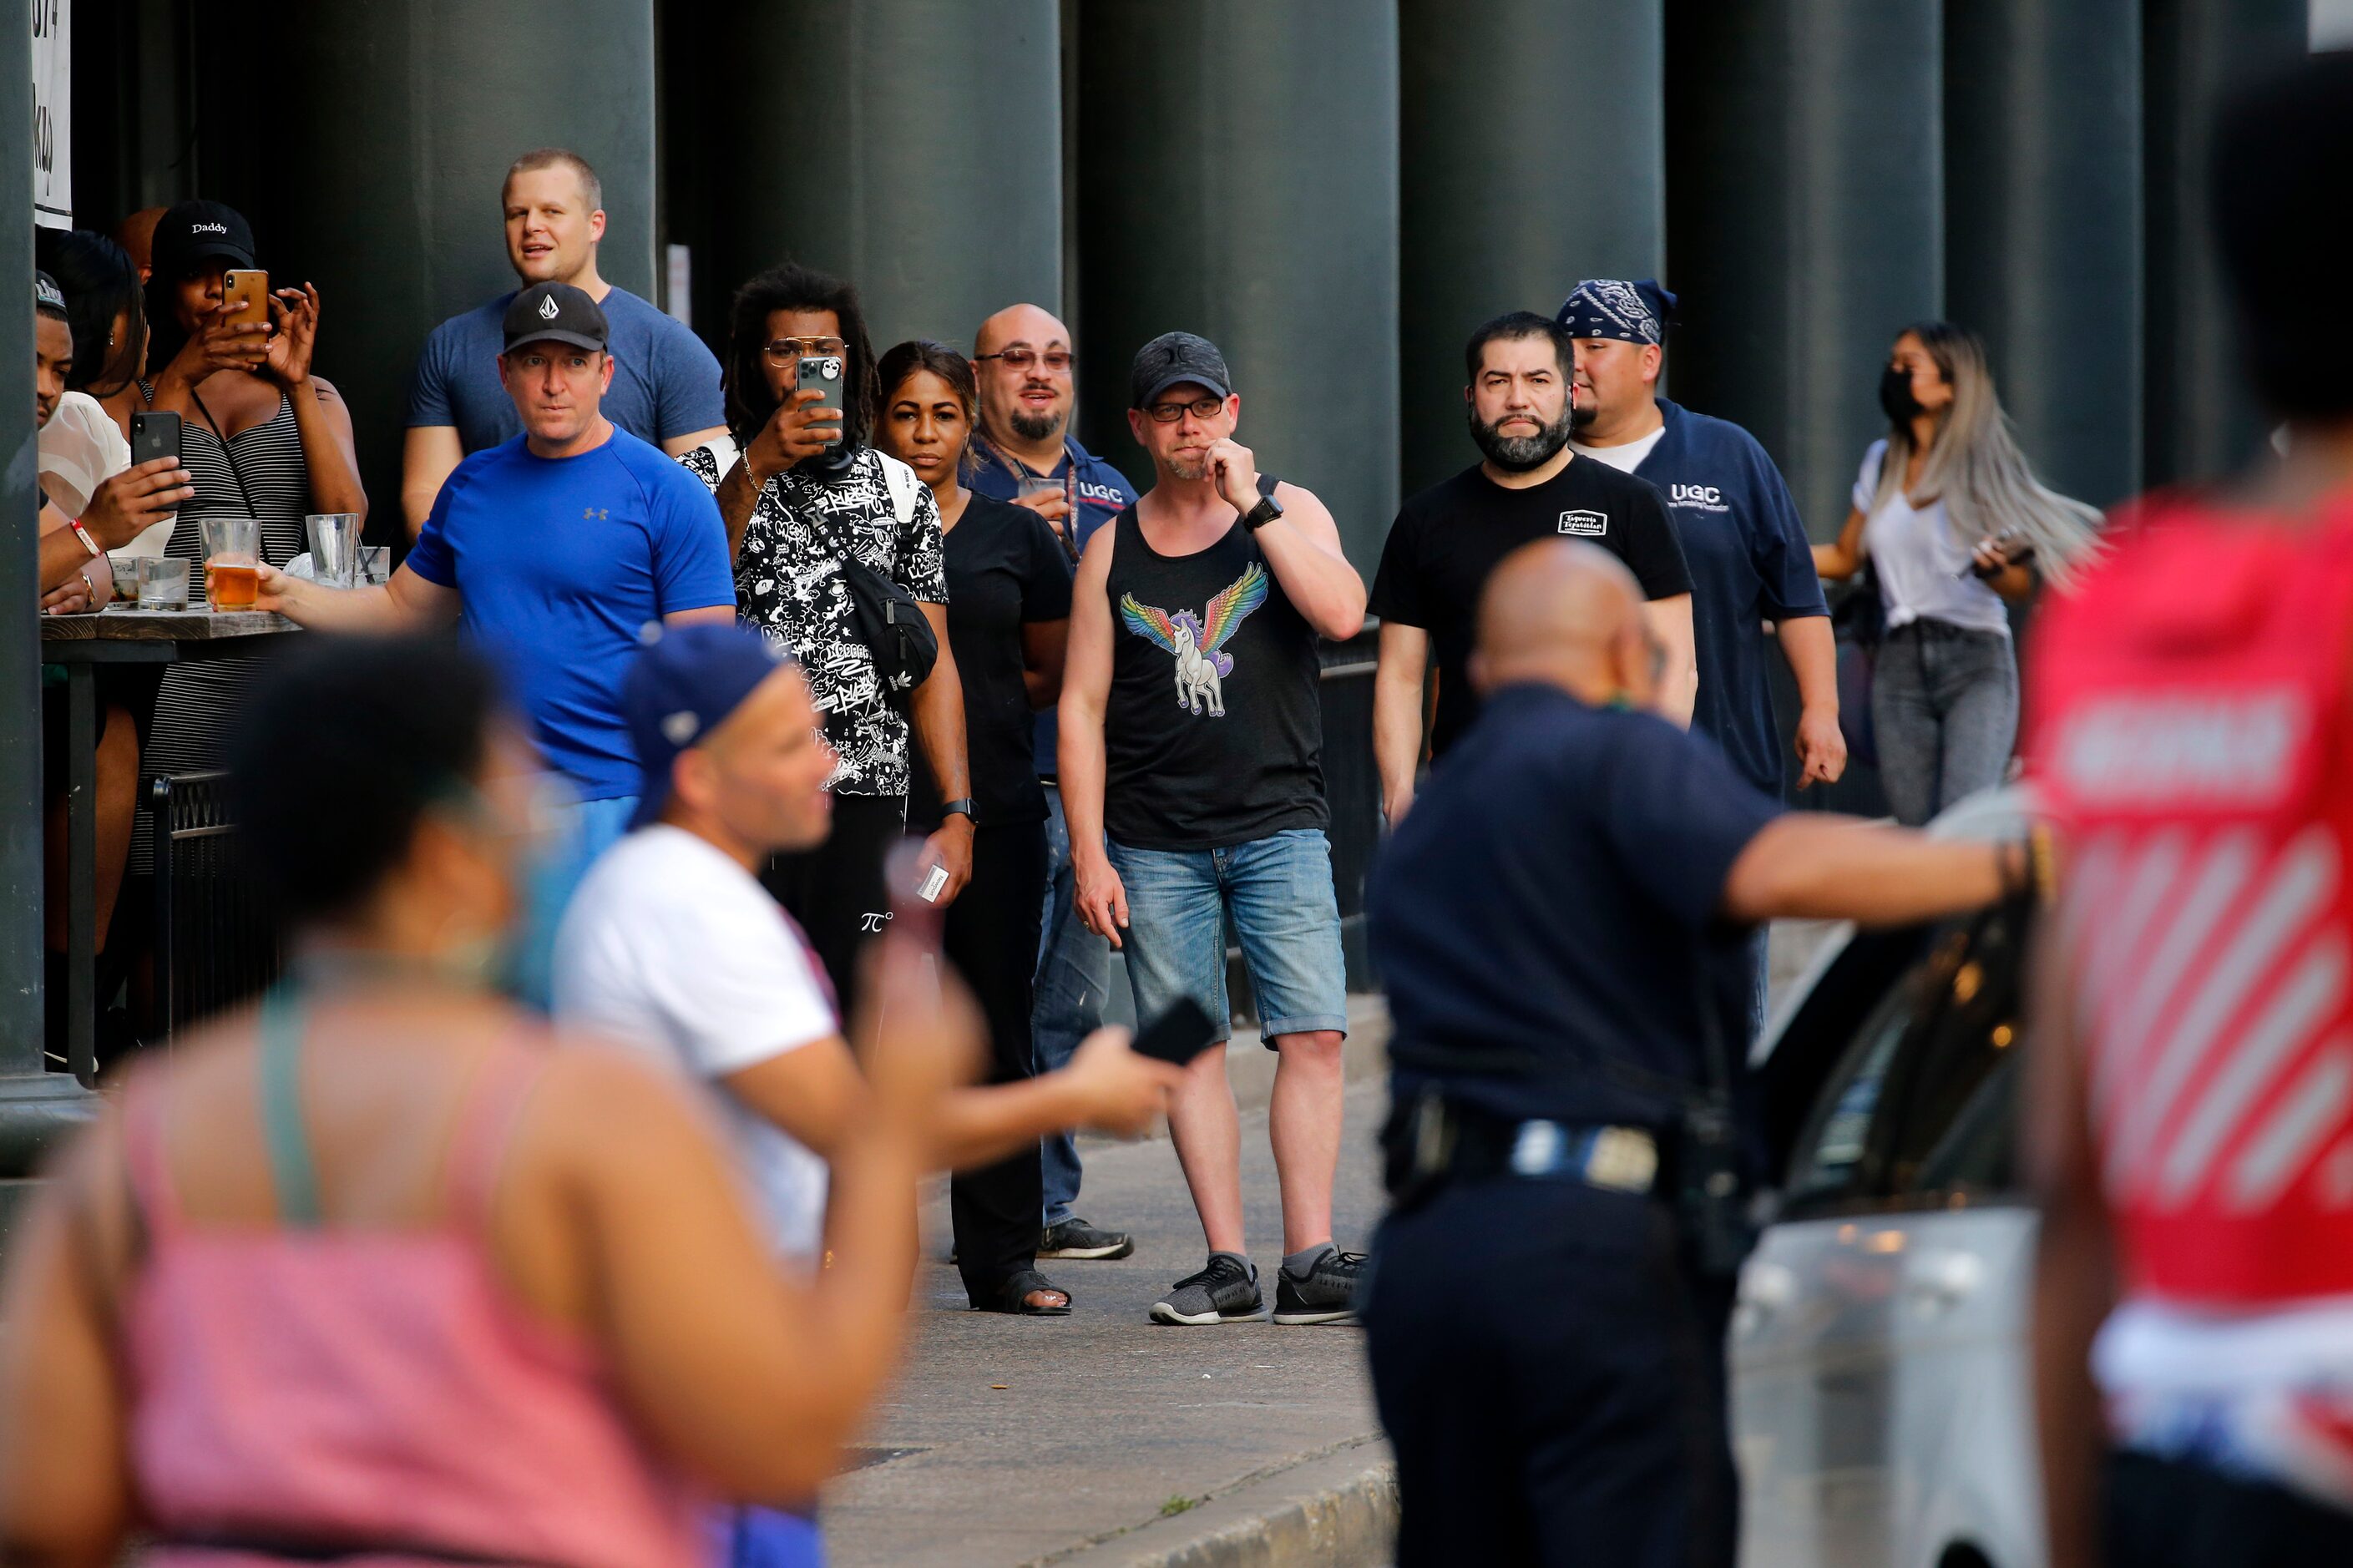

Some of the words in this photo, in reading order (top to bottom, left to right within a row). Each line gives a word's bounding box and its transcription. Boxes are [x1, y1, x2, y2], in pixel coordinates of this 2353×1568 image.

[192, 222, 227, 235] Daddy
[1080, 481, 1123, 503] UGC
[1671, 483, 1721, 503] UGC
[929, 875, 944, 897] Newport
